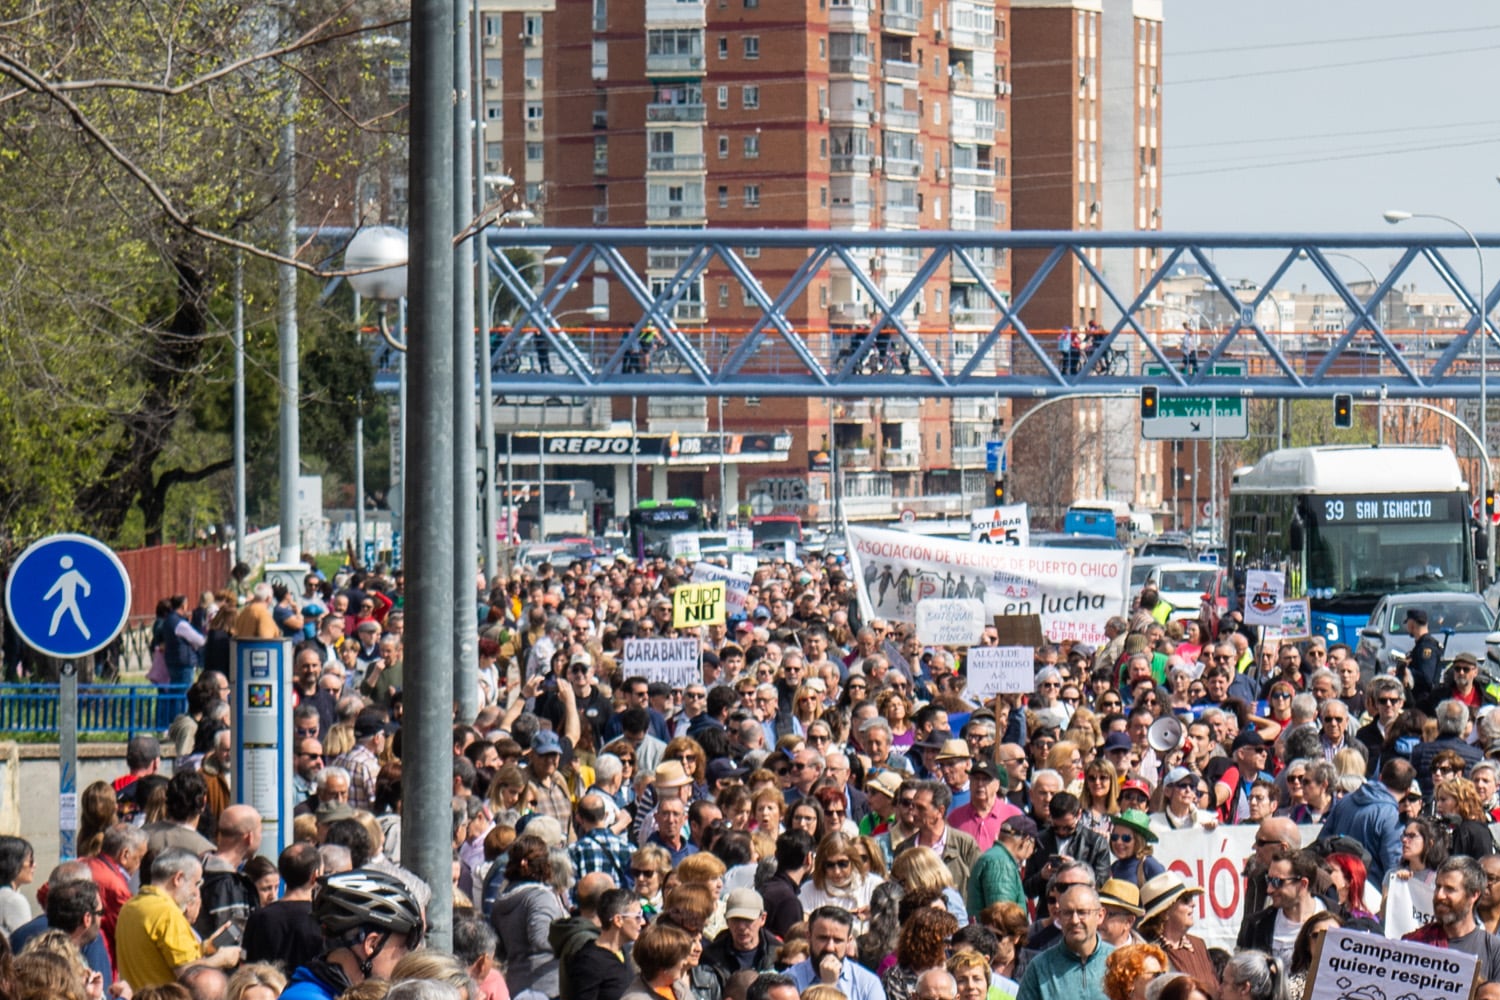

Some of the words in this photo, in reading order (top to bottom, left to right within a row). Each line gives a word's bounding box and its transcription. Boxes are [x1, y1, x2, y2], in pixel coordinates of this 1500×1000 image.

[549, 437, 642, 453] REPSOL
[1325, 500, 1344, 520] 39
[1356, 501, 1378, 519] SAN
[1383, 500, 1431, 518] IGNACIO
[971, 517, 1022, 530] SOTERRAR
[856, 540, 931, 561] ASOCIACIÓN
[935, 548, 951, 563] DE
[1029, 560, 1077, 576] PUERTO
[1080, 562, 1118, 578] CHICO
[1004, 601, 1031, 616] en
[1041, 590, 1105, 615] lucha
[685, 604, 714, 621] NO
[1053, 621, 1097, 633] CUMPLE
[975, 649, 1019, 658] ALCALDE
[973, 660, 1030, 669] MENTIROSO
[1340, 937, 1460, 974] Campamento
[1329, 957, 1387, 978] quiere
[1391, 967, 1464, 993] respirar
